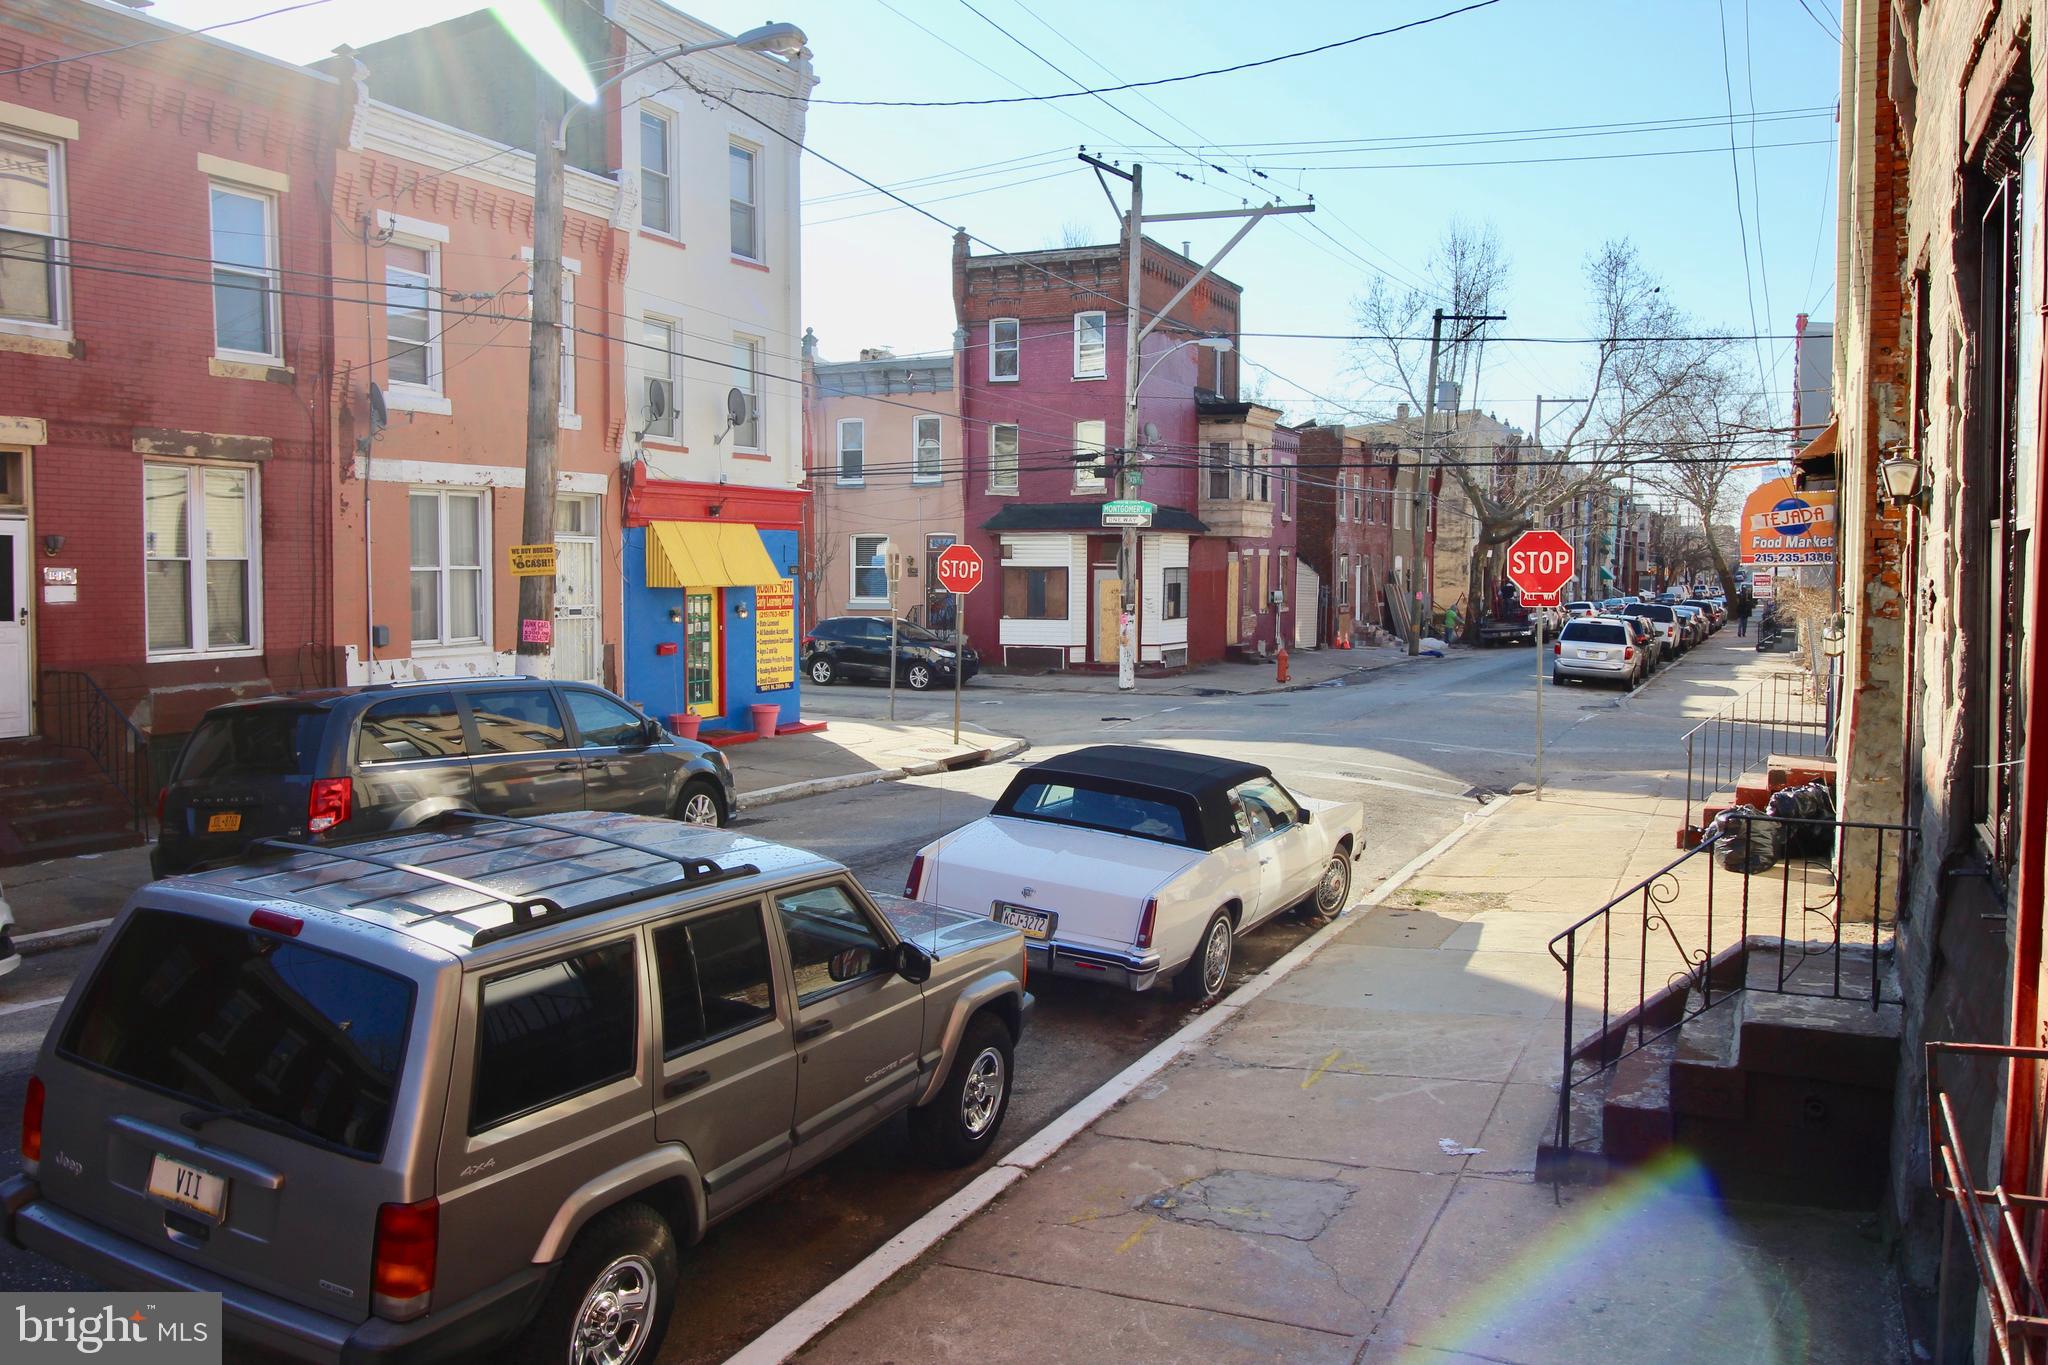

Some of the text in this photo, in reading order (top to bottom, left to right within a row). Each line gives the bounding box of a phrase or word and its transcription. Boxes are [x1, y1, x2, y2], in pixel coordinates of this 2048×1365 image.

[1103, 504, 1143, 513] MONTGOMERY
[1761, 507, 1824, 527] TEJADA
[1752, 535, 1833, 548] Food Market
[941, 559, 979, 579] STOP
[1512, 550, 1569, 574] STOP
[56, 1151, 83, 1175] Jeep
[175, 1167, 202, 1200] VII
